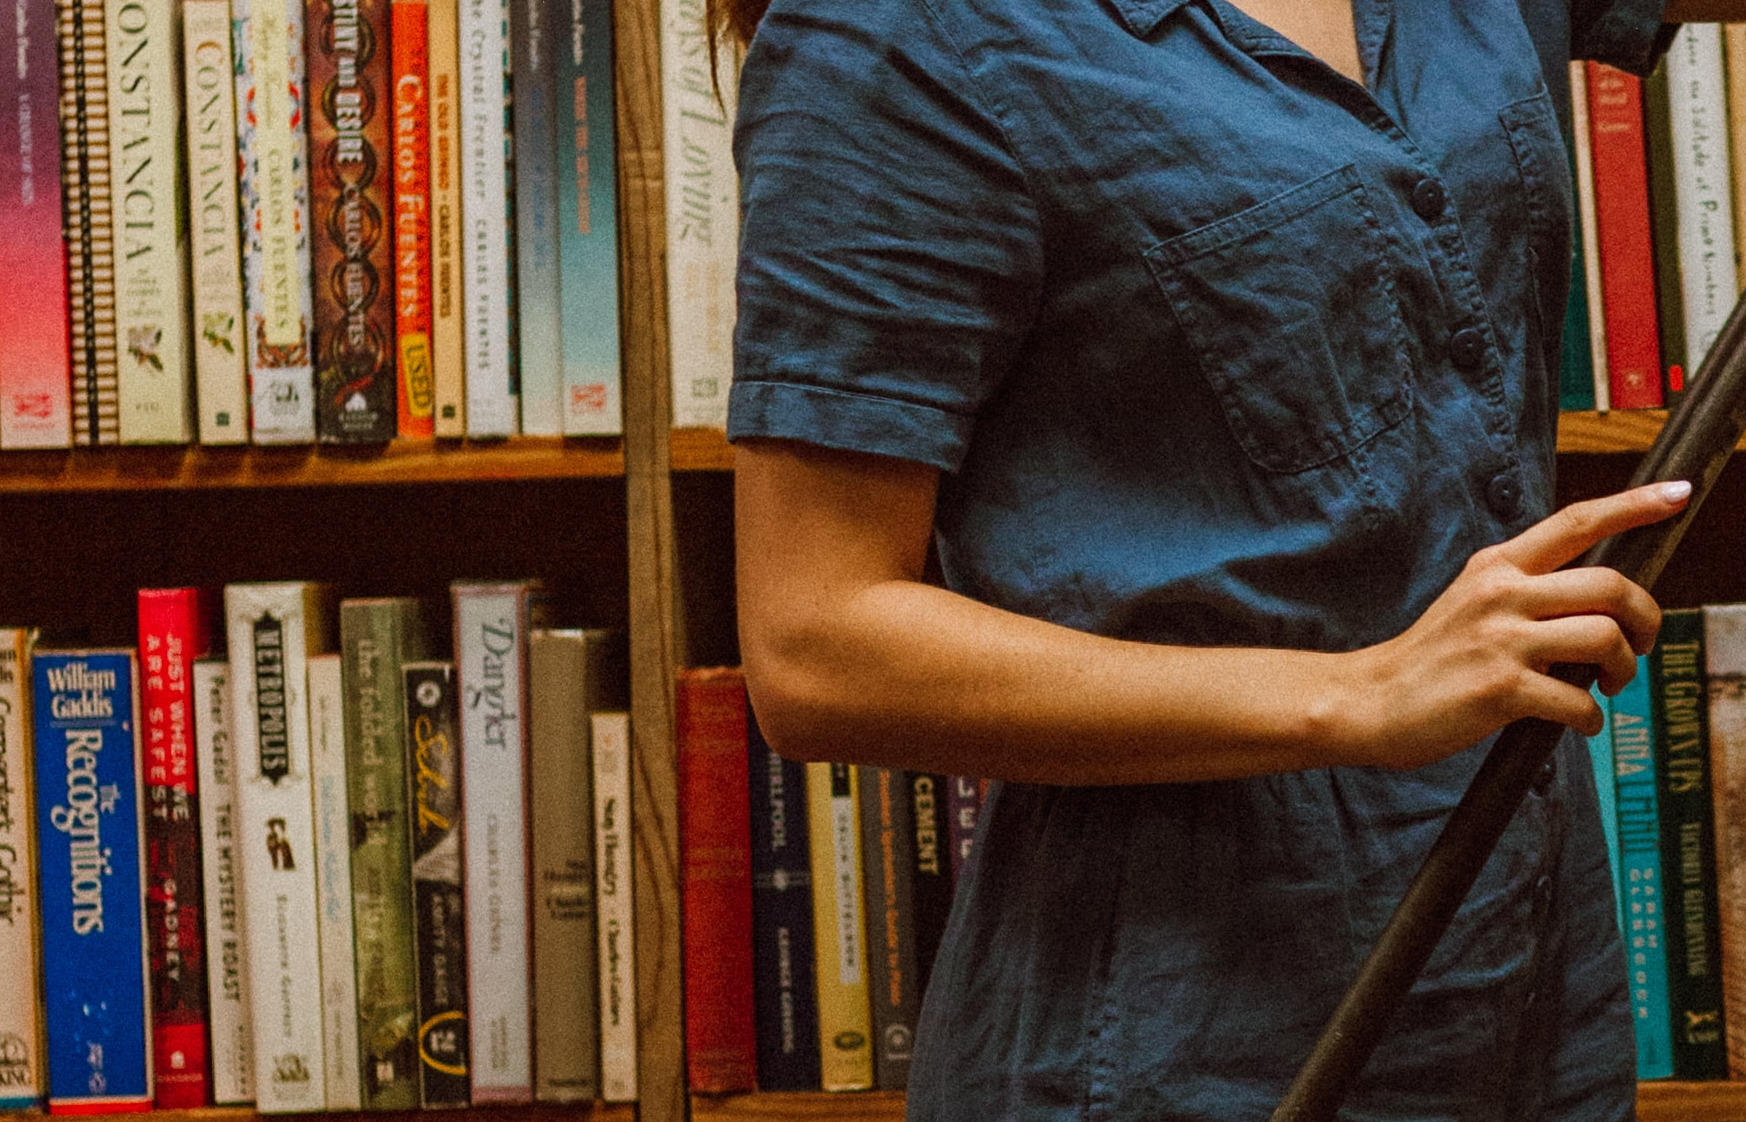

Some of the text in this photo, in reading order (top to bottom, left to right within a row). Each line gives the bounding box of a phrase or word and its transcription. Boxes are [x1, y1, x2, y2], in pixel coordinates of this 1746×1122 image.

[337, 56, 357, 87] AND
[192, 39, 227, 258] CONSTANCIA
[335, 93, 364, 163] DESIRE
[679, 107, 730, 248] Loving
[267, 147, 286, 227] CARLOS
[395, 72, 427, 318] CARLOS FUENTES
[270, 235, 290, 329] FUENTES
[342, 183, 365, 347] CARLOS FUENTES
[405, 343, 433, 410] USED
[47, 663, 116, 692] William
[50, 692, 114, 720] Gaddis
[256, 628, 286, 771] METROPOLIS
[1661, 640, 1702, 676] THE
[147, 633, 168, 821] ARE SAFEST
[164, 633, 190, 821] JUST WHEN WE
[209, 675, 230, 785] Peter Gadol
[359, 685, 386, 766] folded
[50, 728, 121, 936] The Recognitions
[913, 776, 939, 875] CEMENT
[161, 880, 181, 982] GADNEY
[215, 803, 242, 1003] THE MYSTERY ROAST
